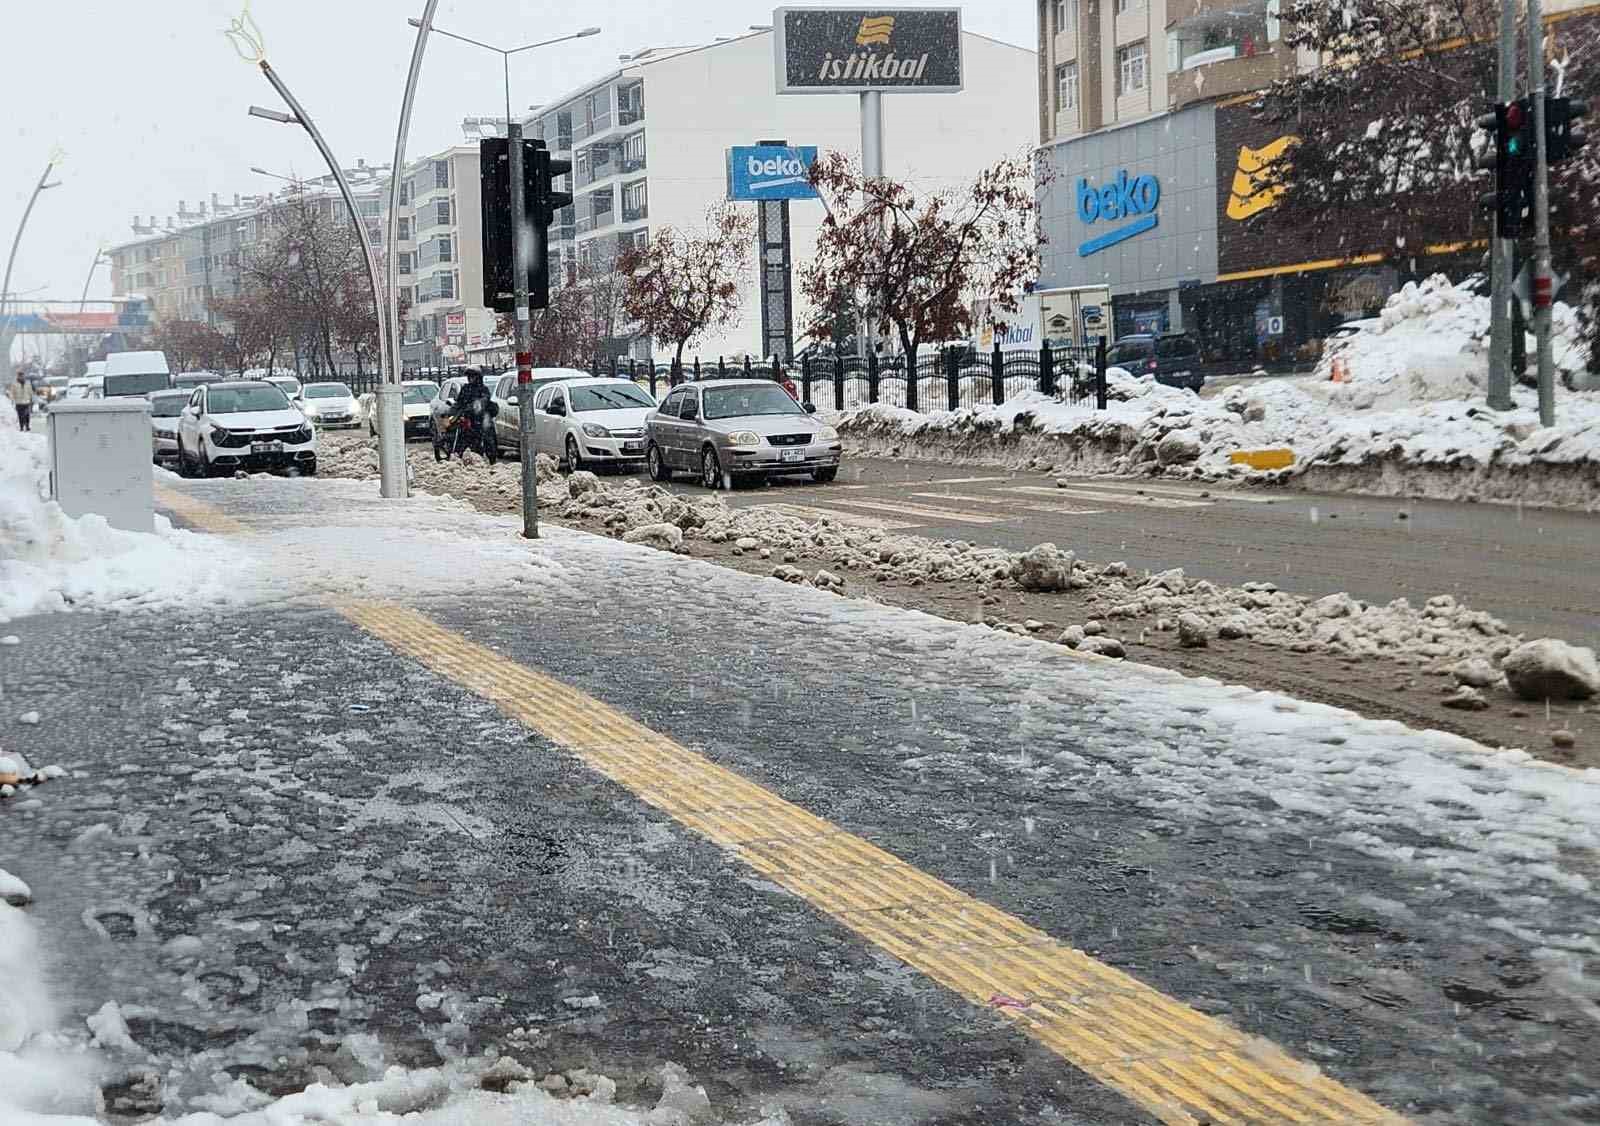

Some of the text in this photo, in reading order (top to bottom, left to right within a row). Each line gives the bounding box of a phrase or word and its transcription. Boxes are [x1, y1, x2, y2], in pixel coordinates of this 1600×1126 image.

[818, 51, 929, 80] istikbal
[748, 155, 803, 176] beko
[1076, 168, 1160, 224] beko
